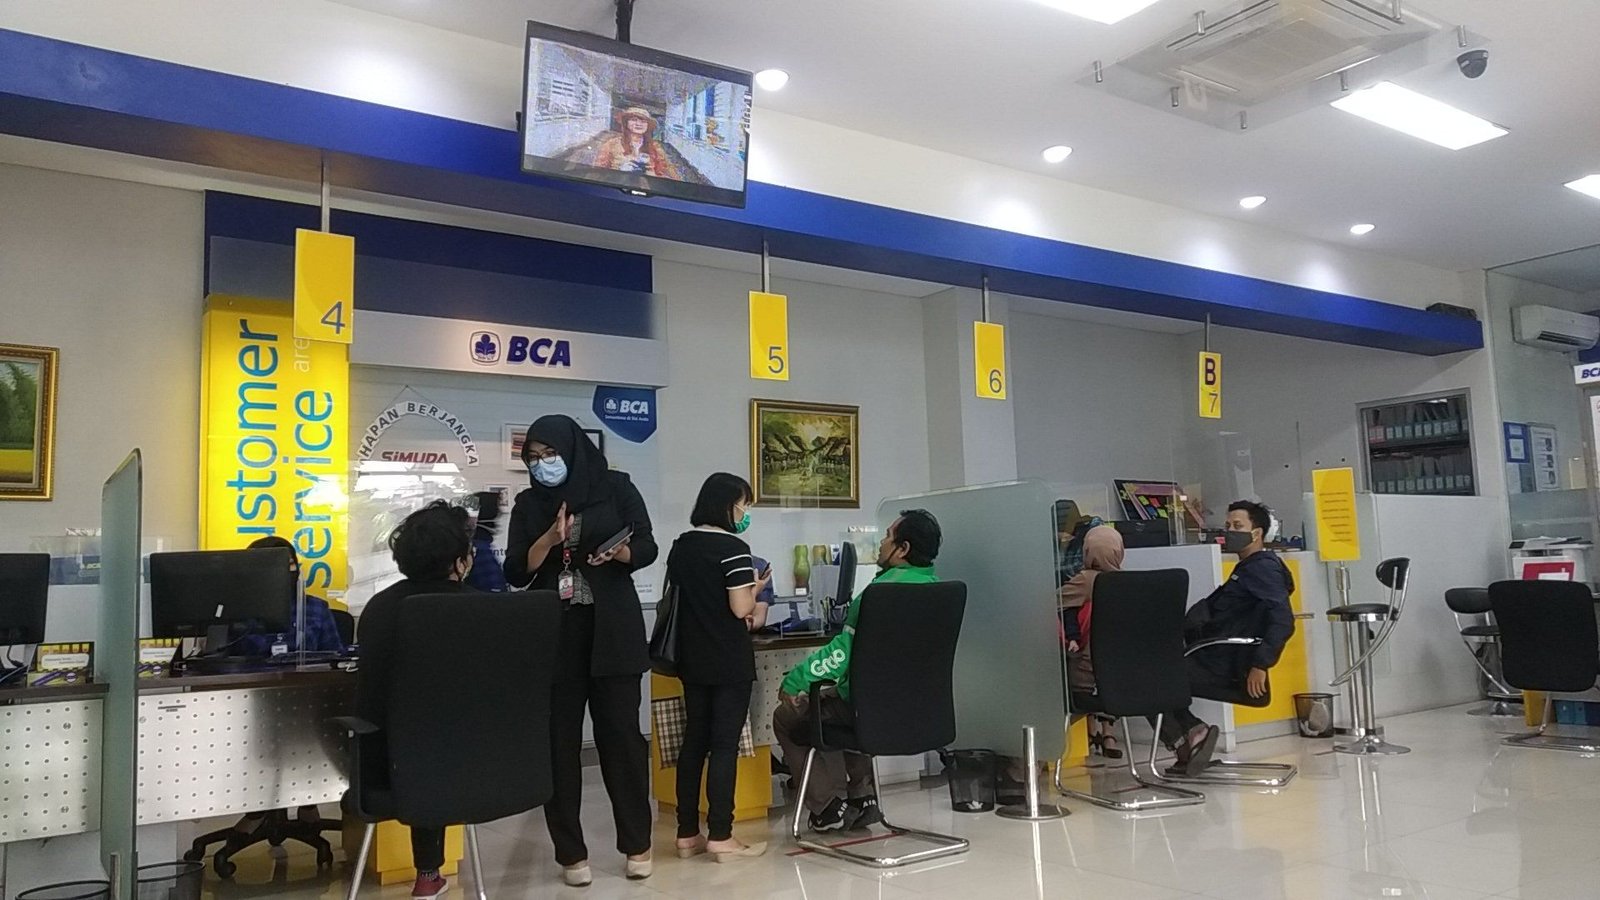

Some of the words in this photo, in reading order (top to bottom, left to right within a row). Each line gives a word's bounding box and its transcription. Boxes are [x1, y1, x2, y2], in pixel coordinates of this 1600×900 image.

[321, 301, 346, 334] 4
[506, 335, 571, 367] BCA
[767, 346, 785, 374] 5
[988, 369, 1003, 394] 6
[1204, 357, 1217, 386] B
[1581, 367, 1600, 379] BC
[619, 399, 649, 415] BCA
[1208, 393, 1219, 413] 7
[407, 402, 478, 465] BERJANGKA
